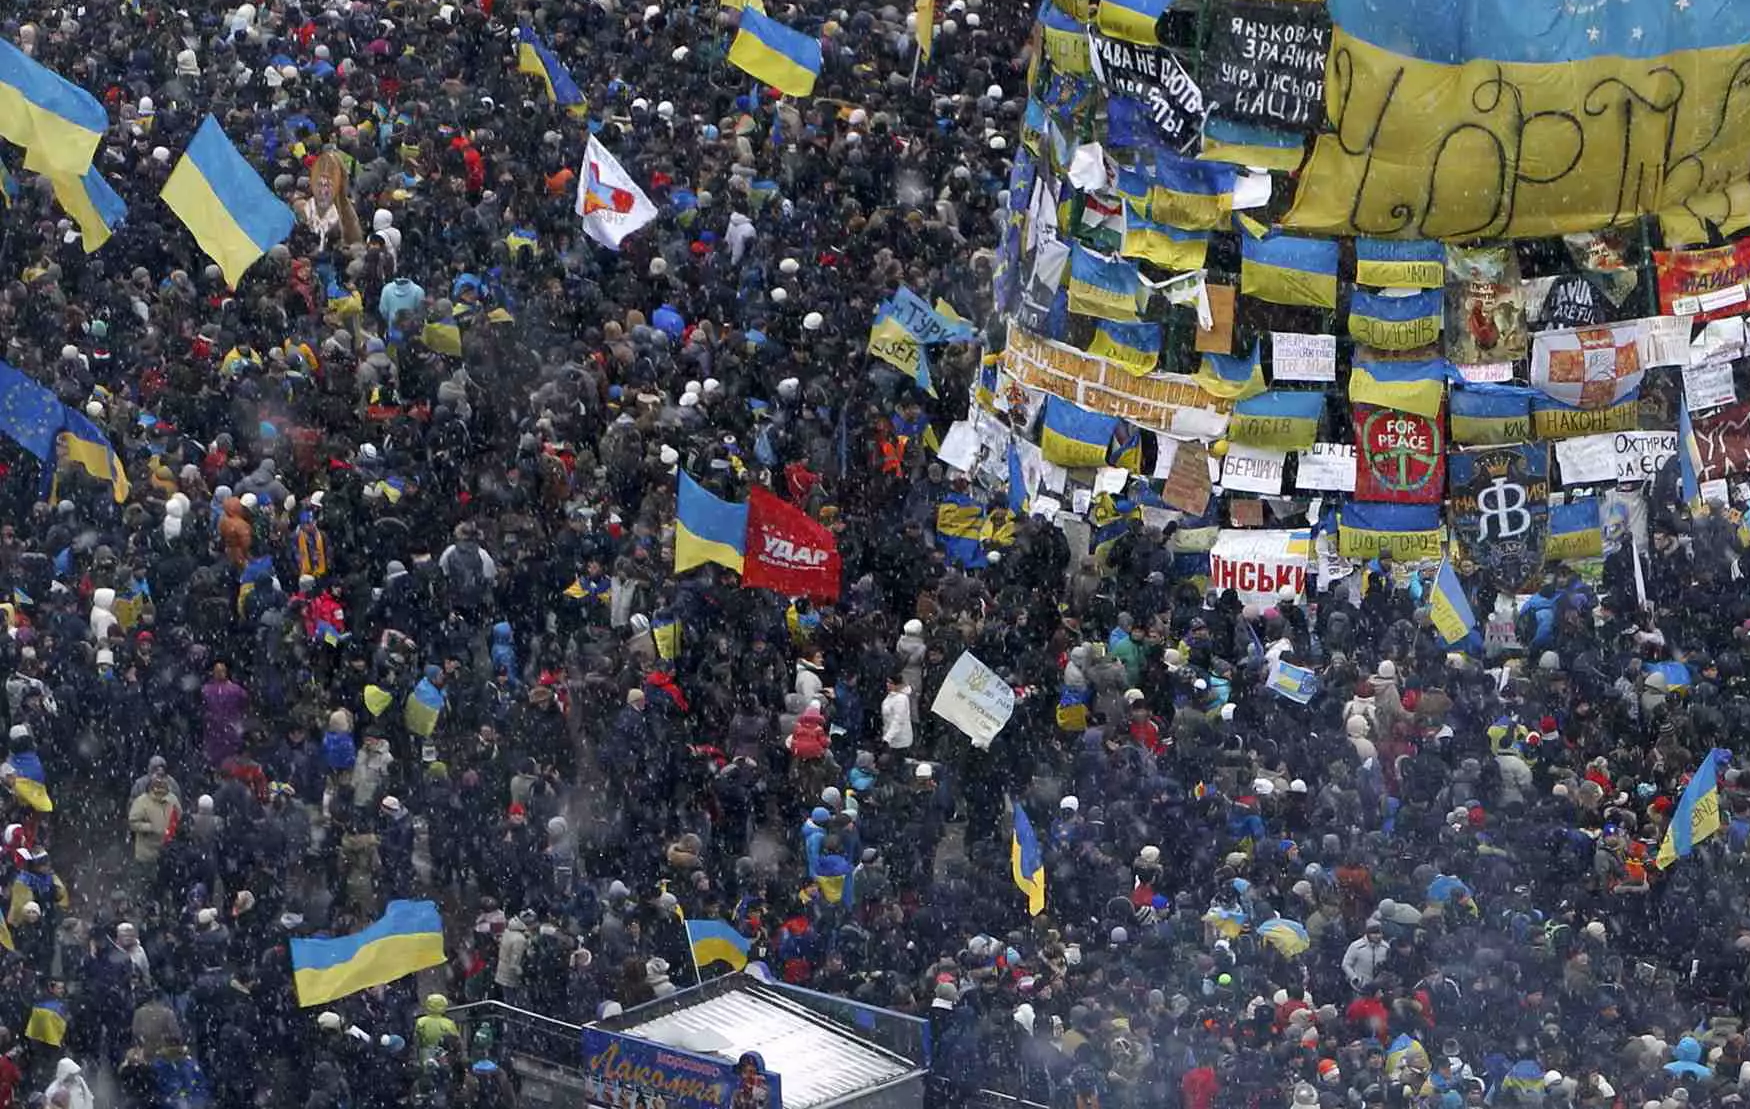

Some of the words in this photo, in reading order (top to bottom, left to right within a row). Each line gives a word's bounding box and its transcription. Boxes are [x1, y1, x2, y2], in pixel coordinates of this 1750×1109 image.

[1386, 419, 1417, 435] FOR
[1378, 434, 1428, 450] PEACE
[763, 536, 829, 565] УДАР
